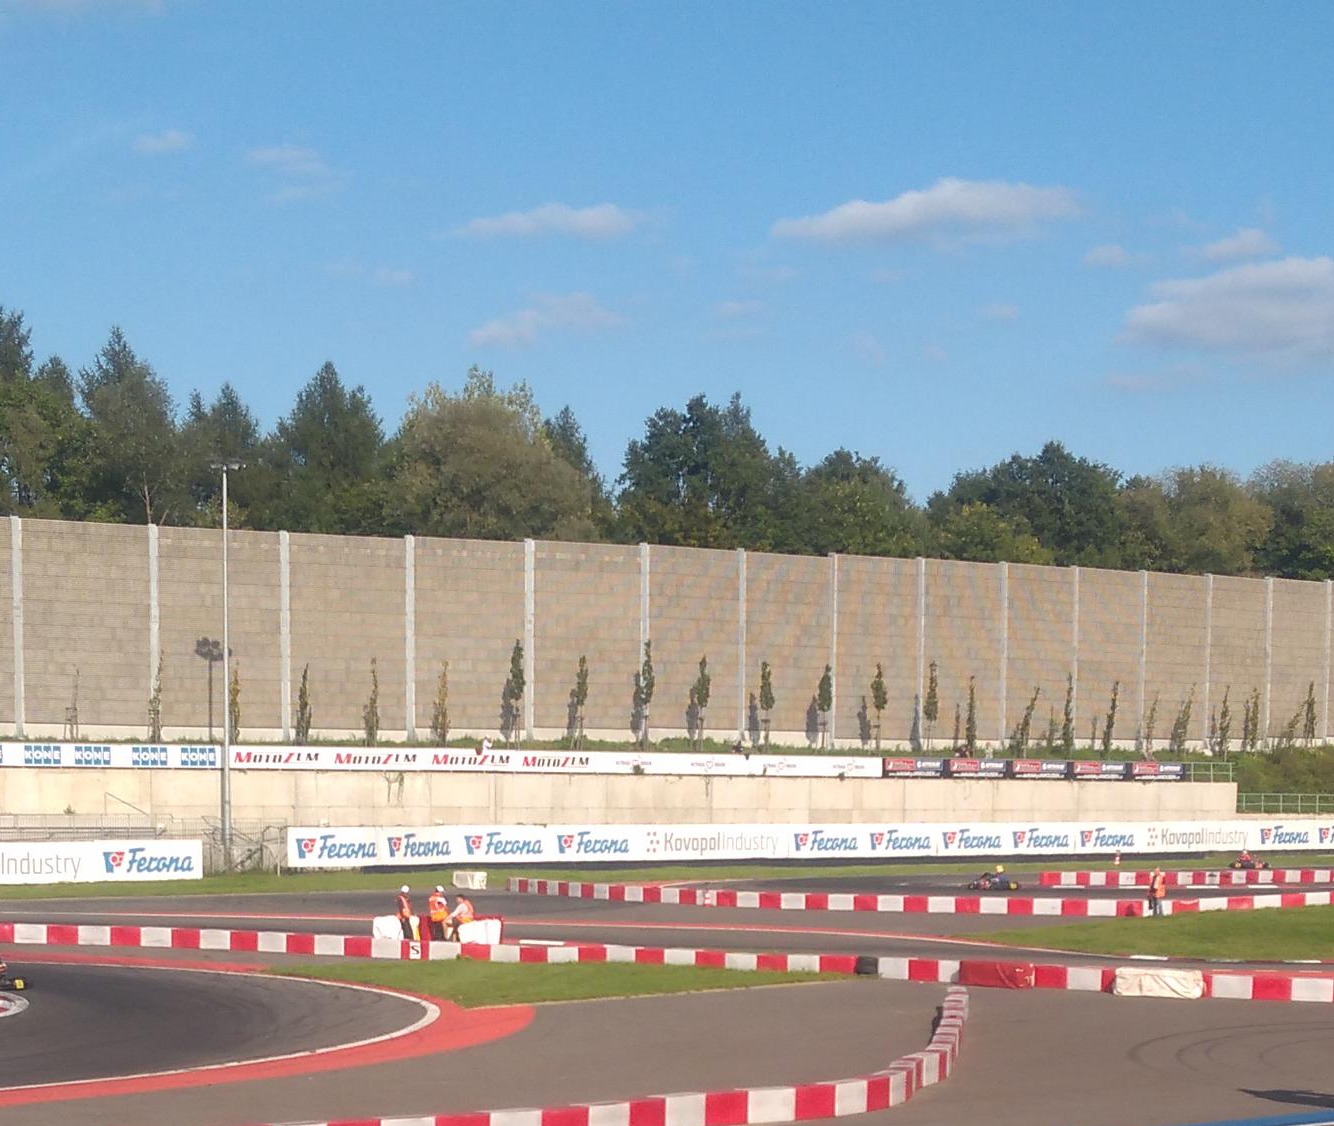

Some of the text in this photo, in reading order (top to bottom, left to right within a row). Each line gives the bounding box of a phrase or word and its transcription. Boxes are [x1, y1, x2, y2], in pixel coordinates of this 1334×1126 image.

[24, 745, 61, 764] KONE
[74, 746, 111, 765] KONE
[132, 747, 167, 766] KONE
[181, 747, 216, 767] KONE
[402, 833, 451, 857] Ferona
[485, 832, 543, 855] Ferona
[576, 831, 629, 854] Ferona
[810, 830, 858, 852] Ferona
[886, 829, 931, 850] Ferona
[958, 828, 1001, 849] Ferona
[1023, 828, 1069, 848] Ferona
[1095, 827, 1134, 847] Ferona
[1273, 826, 1309, 845] Ferona
[318, 834, 378, 860] Ferona
[126, 847, 194, 873] Ferona
